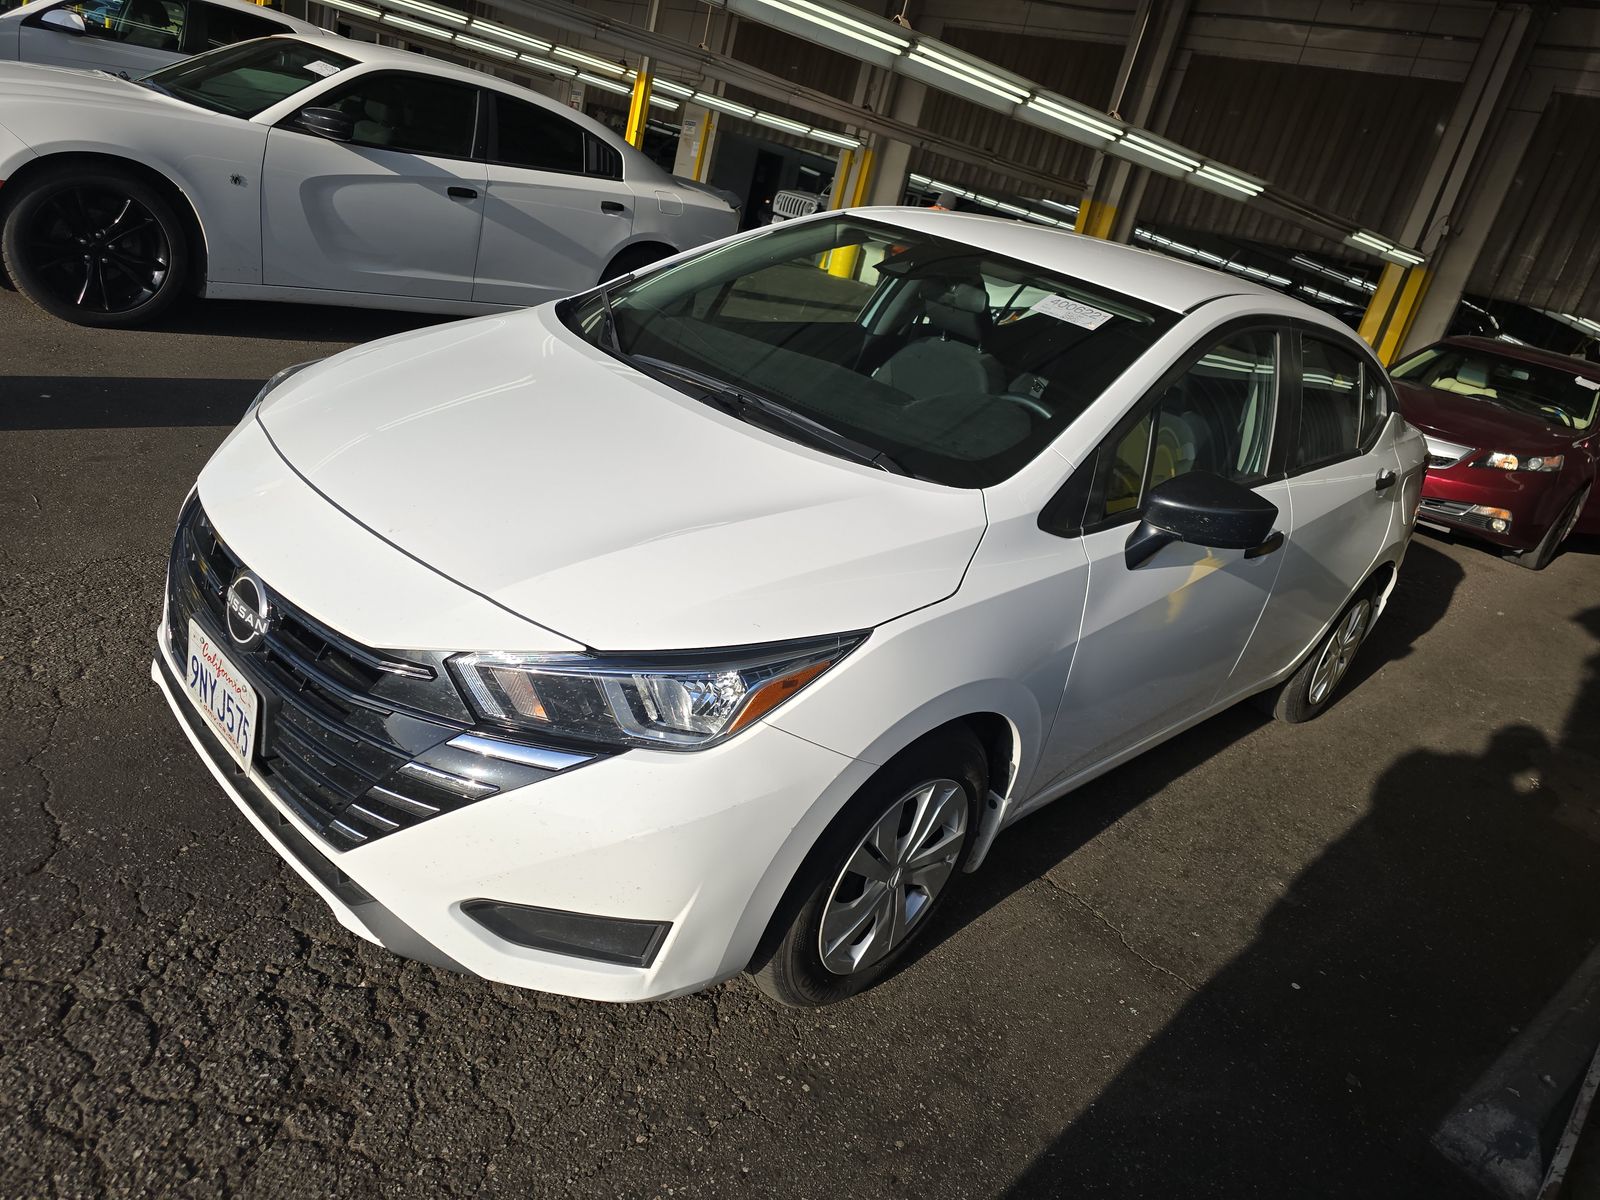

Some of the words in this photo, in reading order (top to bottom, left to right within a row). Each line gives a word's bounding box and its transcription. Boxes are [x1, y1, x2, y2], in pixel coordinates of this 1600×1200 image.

[1050, 298, 1109, 322] 4006221
[227, 590, 267, 634] NISSAN
[202, 642, 245, 703] California
[191, 655, 249, 758] 9NYJ575
